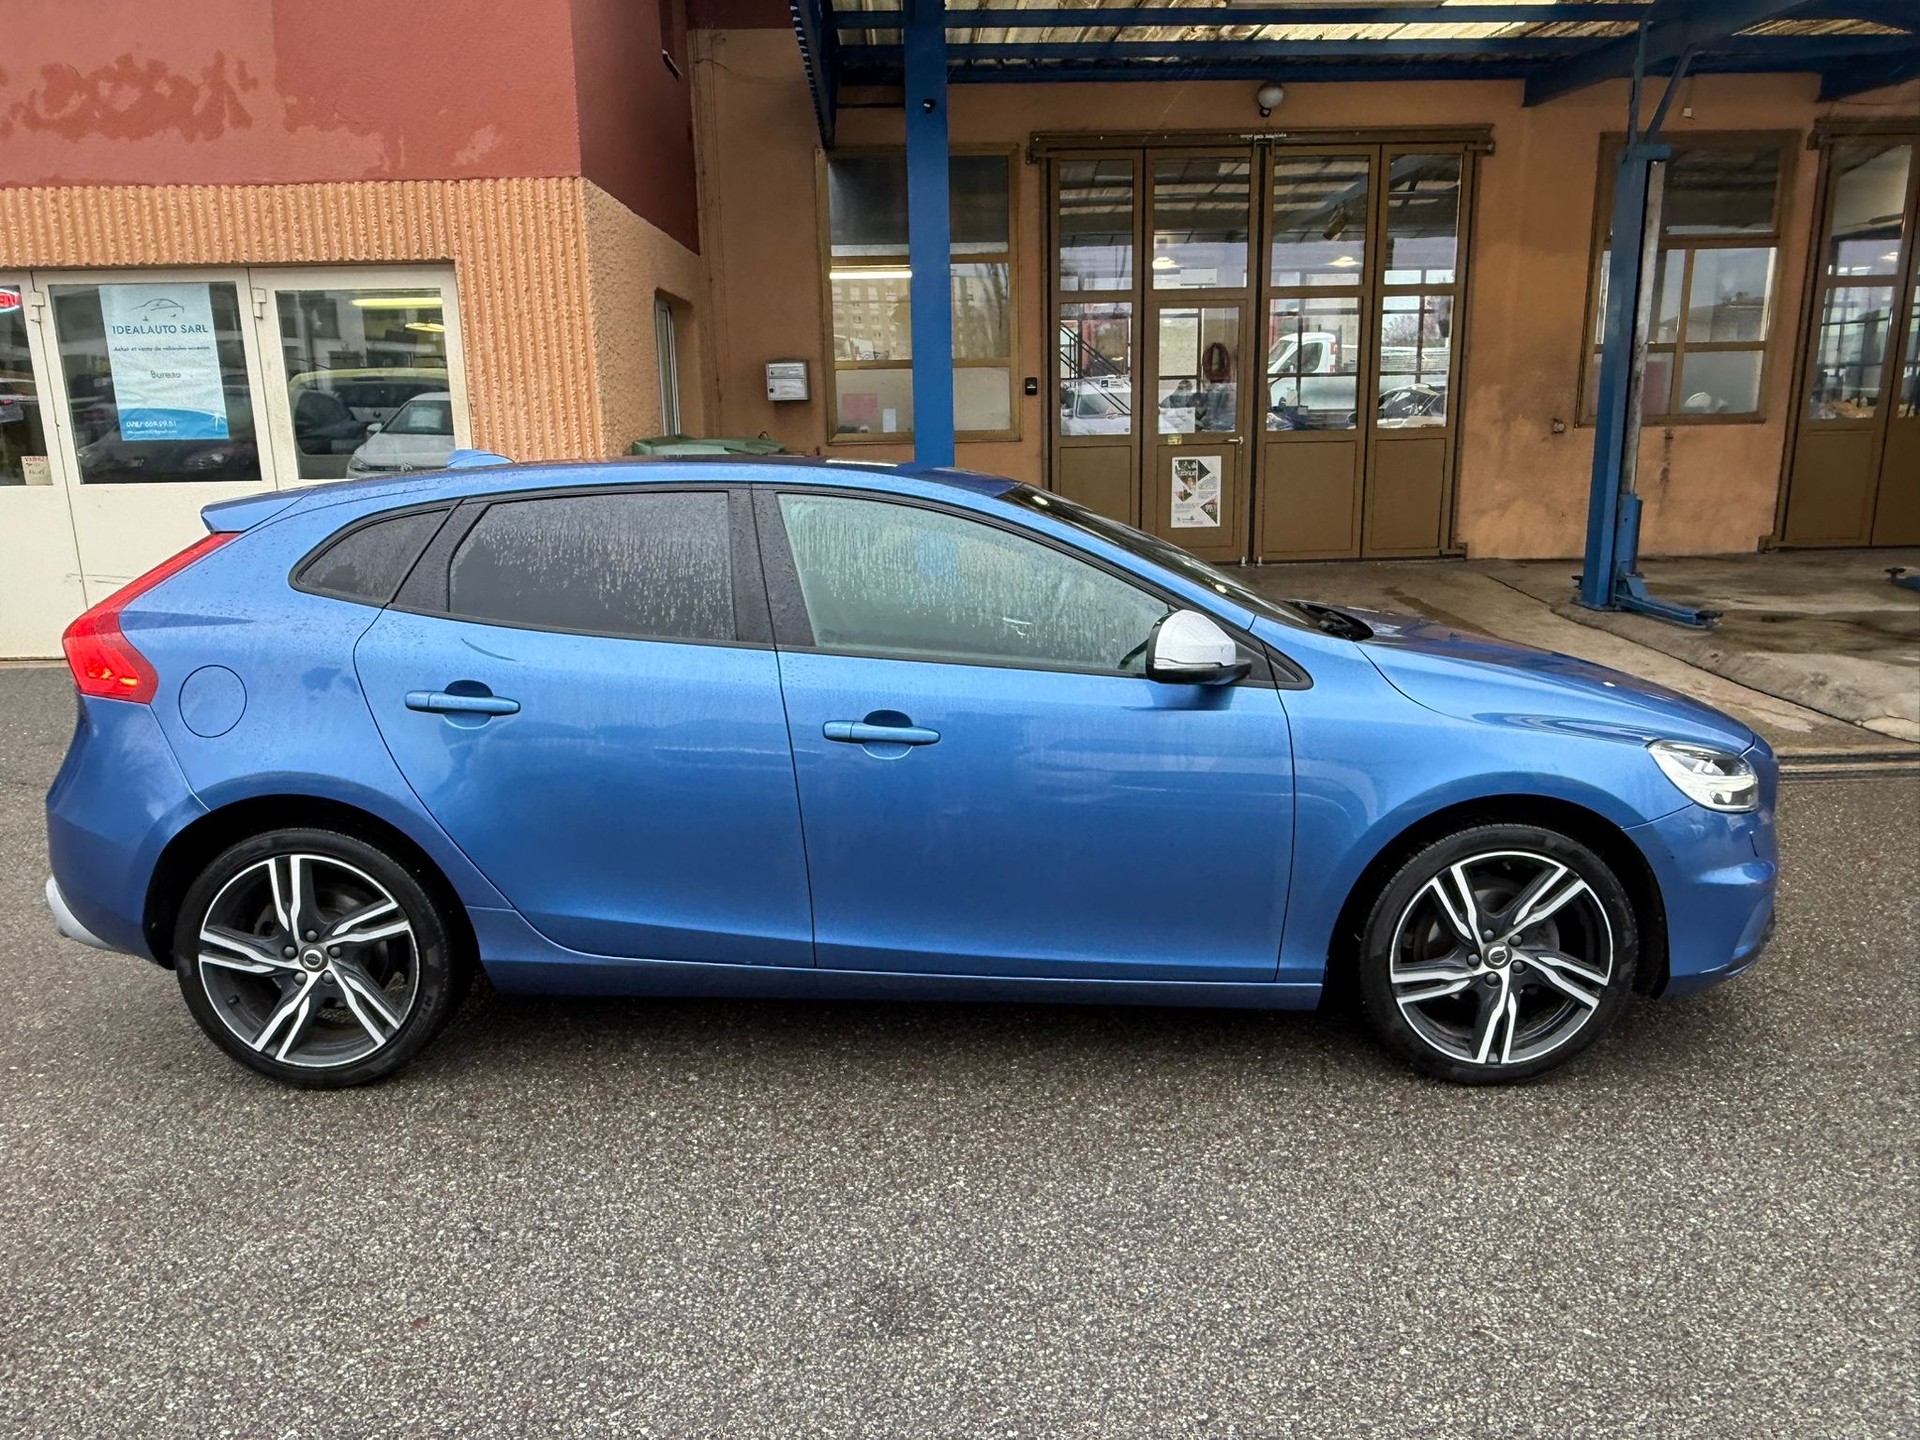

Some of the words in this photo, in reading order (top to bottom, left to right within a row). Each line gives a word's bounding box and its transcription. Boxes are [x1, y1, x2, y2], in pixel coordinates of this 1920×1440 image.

[112, 324, 177, 335] IDEALAUTO
[180, 323, 209, 334] SARL
[150, 370, 181, 379] Bureau
